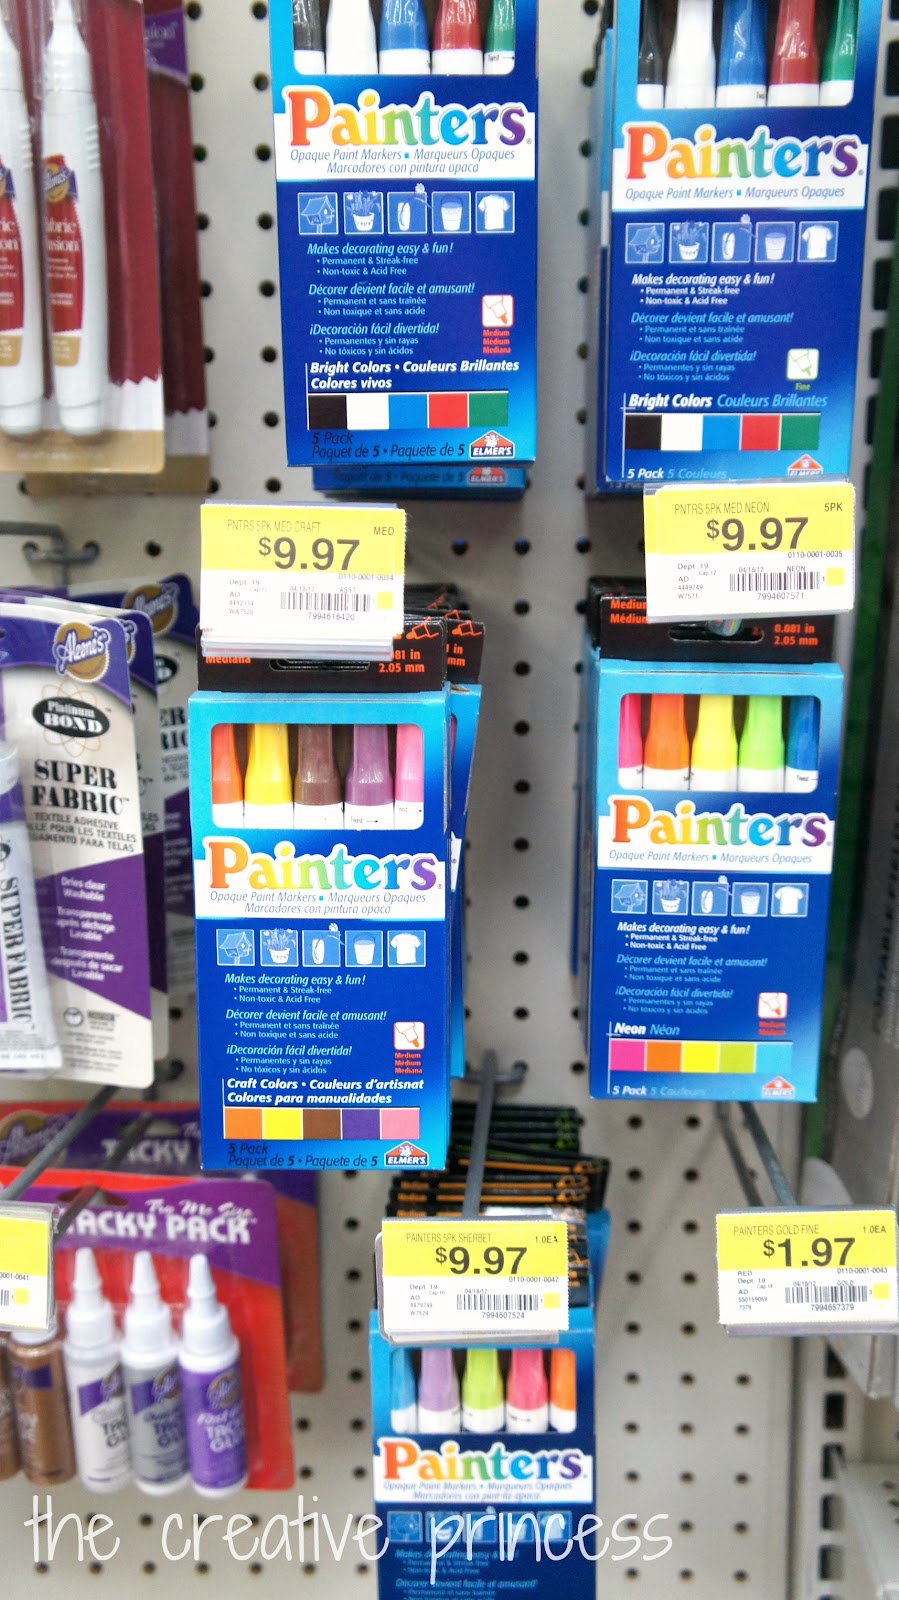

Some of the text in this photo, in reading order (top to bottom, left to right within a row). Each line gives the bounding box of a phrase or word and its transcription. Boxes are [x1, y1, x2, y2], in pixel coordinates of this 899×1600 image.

[288, 90, 526, 146] Painters
[291, 149, 515, 162] Opaque Paint Markers Marqueurs Opaques
[626, 127, 858, 179] Painters
[327, 162, 479, 176] Marcadores con pintura opaca
[625, 186, 845, 201] Opaque Paint Markers Marqueurs Opaques
[308, 243, 453, 256] Makes decorating easy & fun!
[322, 257, 418, 265] Permanent & Streak-free
[323, 267, 360, 275] Non-toxic
[371, 267, 388, 275] Acid
[390, 267, 407, 275] Free
[632, 273, 775, 287] Makes decorating easy & fun!
[309, 283, 475, 295] Décorer devient facile et amusant!
[310, 323, 439, 335] ¡Decoración fácil divertida!
[311, 359, 519, 376] Bright Colors Couleurs Brillantes
[311, 377, 392, 389] Colores vivos
[629, 394, 827, 409] Bright Colors Couleurs Brillantes
[312, 432, 353, 443] 5 Pack
[312, 443, 465, 460] Paquet de 5 Paquete de 5
[473, 447, 512, 456] ELMER'S
[627, 468, 727, 479] 5 Pack 5 Couleurs
[674, 502, 769, 515] PNTRS 5PK MED NEON
[825, 503, 843, 512] 5PK
[227, 520, 321, 533] PNTRS 5PK MED CRAFT
[374, 527, 394, 535] MED
[706, 517, 808, 551] $9.97
[259, 536, 360, 571] $9.97
[774, 624, 814, 634] 0.081 in
[774, 637, 818, 645] 2.05 mm
[56, 631, 106, 671] Aleene's
[379, 663, 424, 672] 2.05 mm
[48, 702, 95, 718] Platinum
[43, 714, 102, 733] BOND
[34, 759, 117, 789] SUPER
[31, 785, 123, 815] FABRIC
[613, 800, 826, 847] Painters
[609, 850, 812, 864] Opaque Paint Markers Marqueurs Opaques
[208, 842, 437, 890] Painters
[210, 891, 425, 904] Opaque Paint Markers Marqueurs Opaques
[0, 877, 23, 948] SUPER
[245, 903, 390, 916] Marcadores con pintura opaca
[7, 952, 32, 1022] FABRIC
[615, 1023, 680, 1035] Neon Néon
[227, 1078, 424, 1090] Craft Colors Couleurs d'artisnat
[613, 1086, 647, 1095] 5 Pack
[228, 1092, 392, 1105] Colores para manualidades
[734, 1225, 819, 1235] PAINTERS GOLD FINE
[863, 1225, 886, 1234] 1.0EA
[406, 1233, 491, 1243] PAINTERS 5PK SHERBET
[763, 1238, 855, 1267] $1.97
[435, 1246, 527, 1275] $9.97
[383, 1442, 582, 1481] Painters
